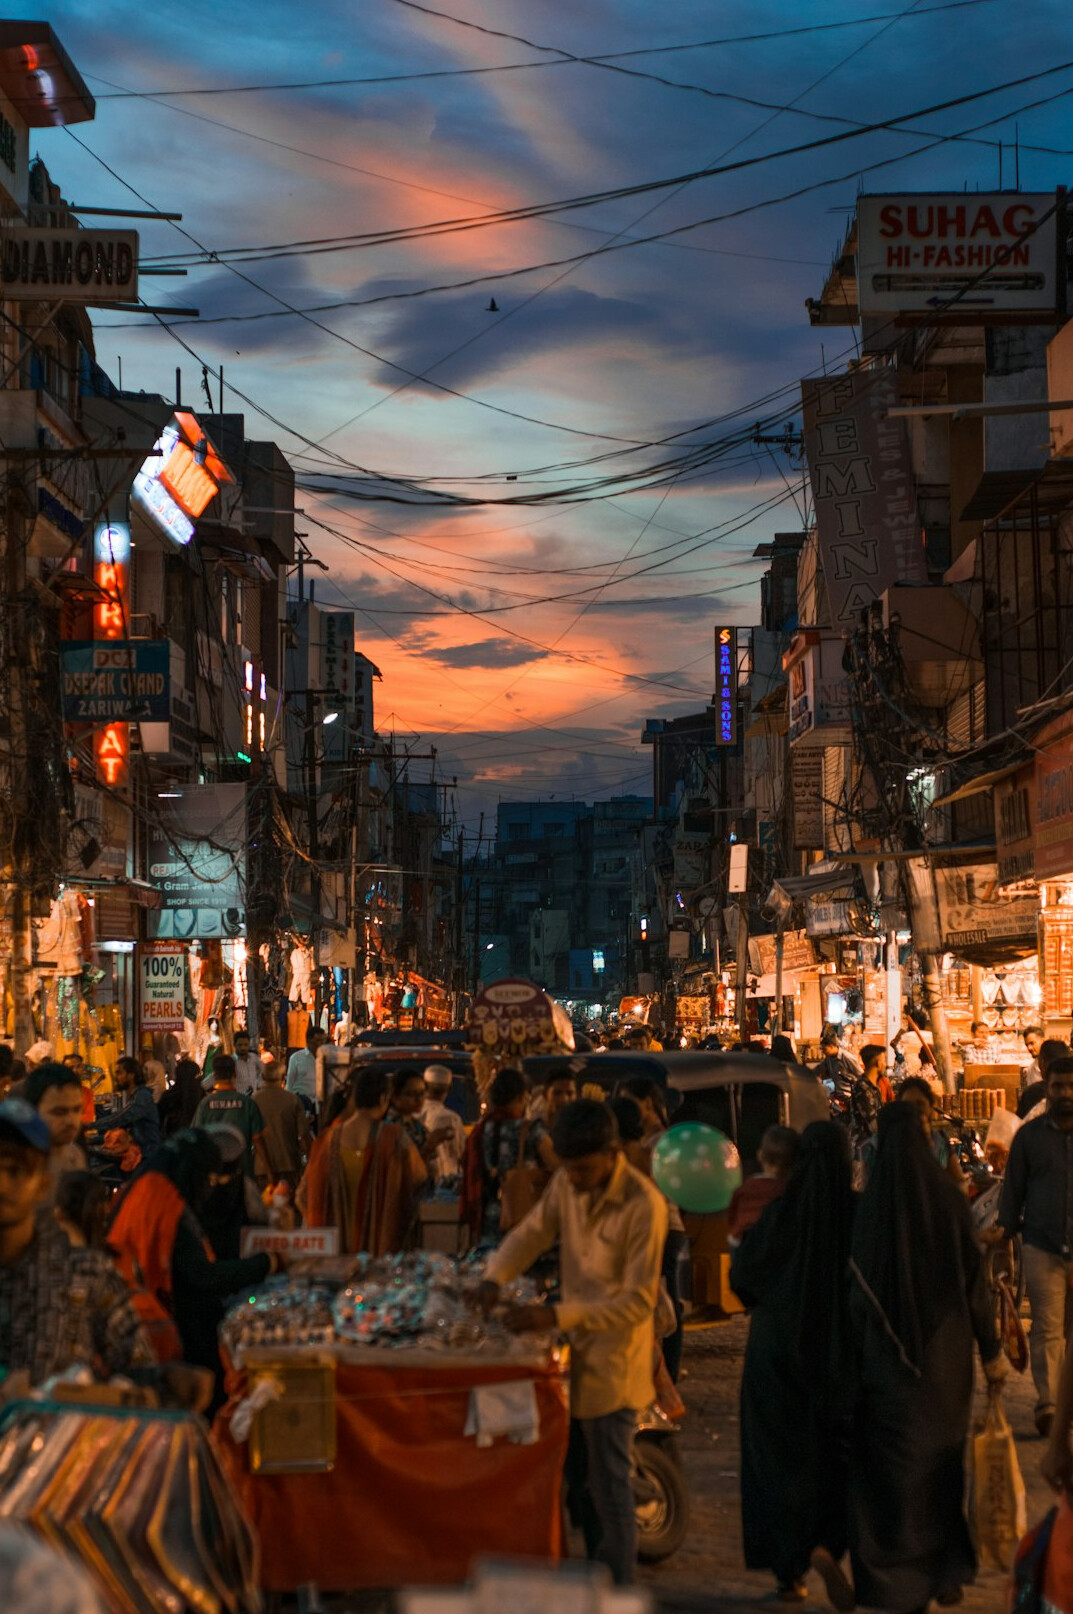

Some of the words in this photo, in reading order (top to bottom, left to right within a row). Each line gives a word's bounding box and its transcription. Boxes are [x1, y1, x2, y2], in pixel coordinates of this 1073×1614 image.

[879, 205, 1038, 238] SUHAG
[4, 239, 132, 285] DIAMOND
[813, 379, 879, 622] FEMINA
[96, 650, 136, 667] DCZ
[719, 645, 732, 686] SAMI
[64, 672, 115, 696] DEEPAK
[120, 672, 165, 696] CHAND
[720, 700, 732, 741] SONS
[164, 881, 189, 891] Gram
[166, 898, 187, 906] SHOP
[188, 898, 210, 906] SINCE
[948, 930, 987, 946] WHOLESALE
[143, 957, 182, 977] 100%
[145, 980, 180, 989] Guaranteed
[152, 990, 174, 998] Natural
[143, 1001, 182, 1018] PEARLS
[252, 1236, 288, 1249] FIXED
[294, 1236, 325, 1250] RATE
